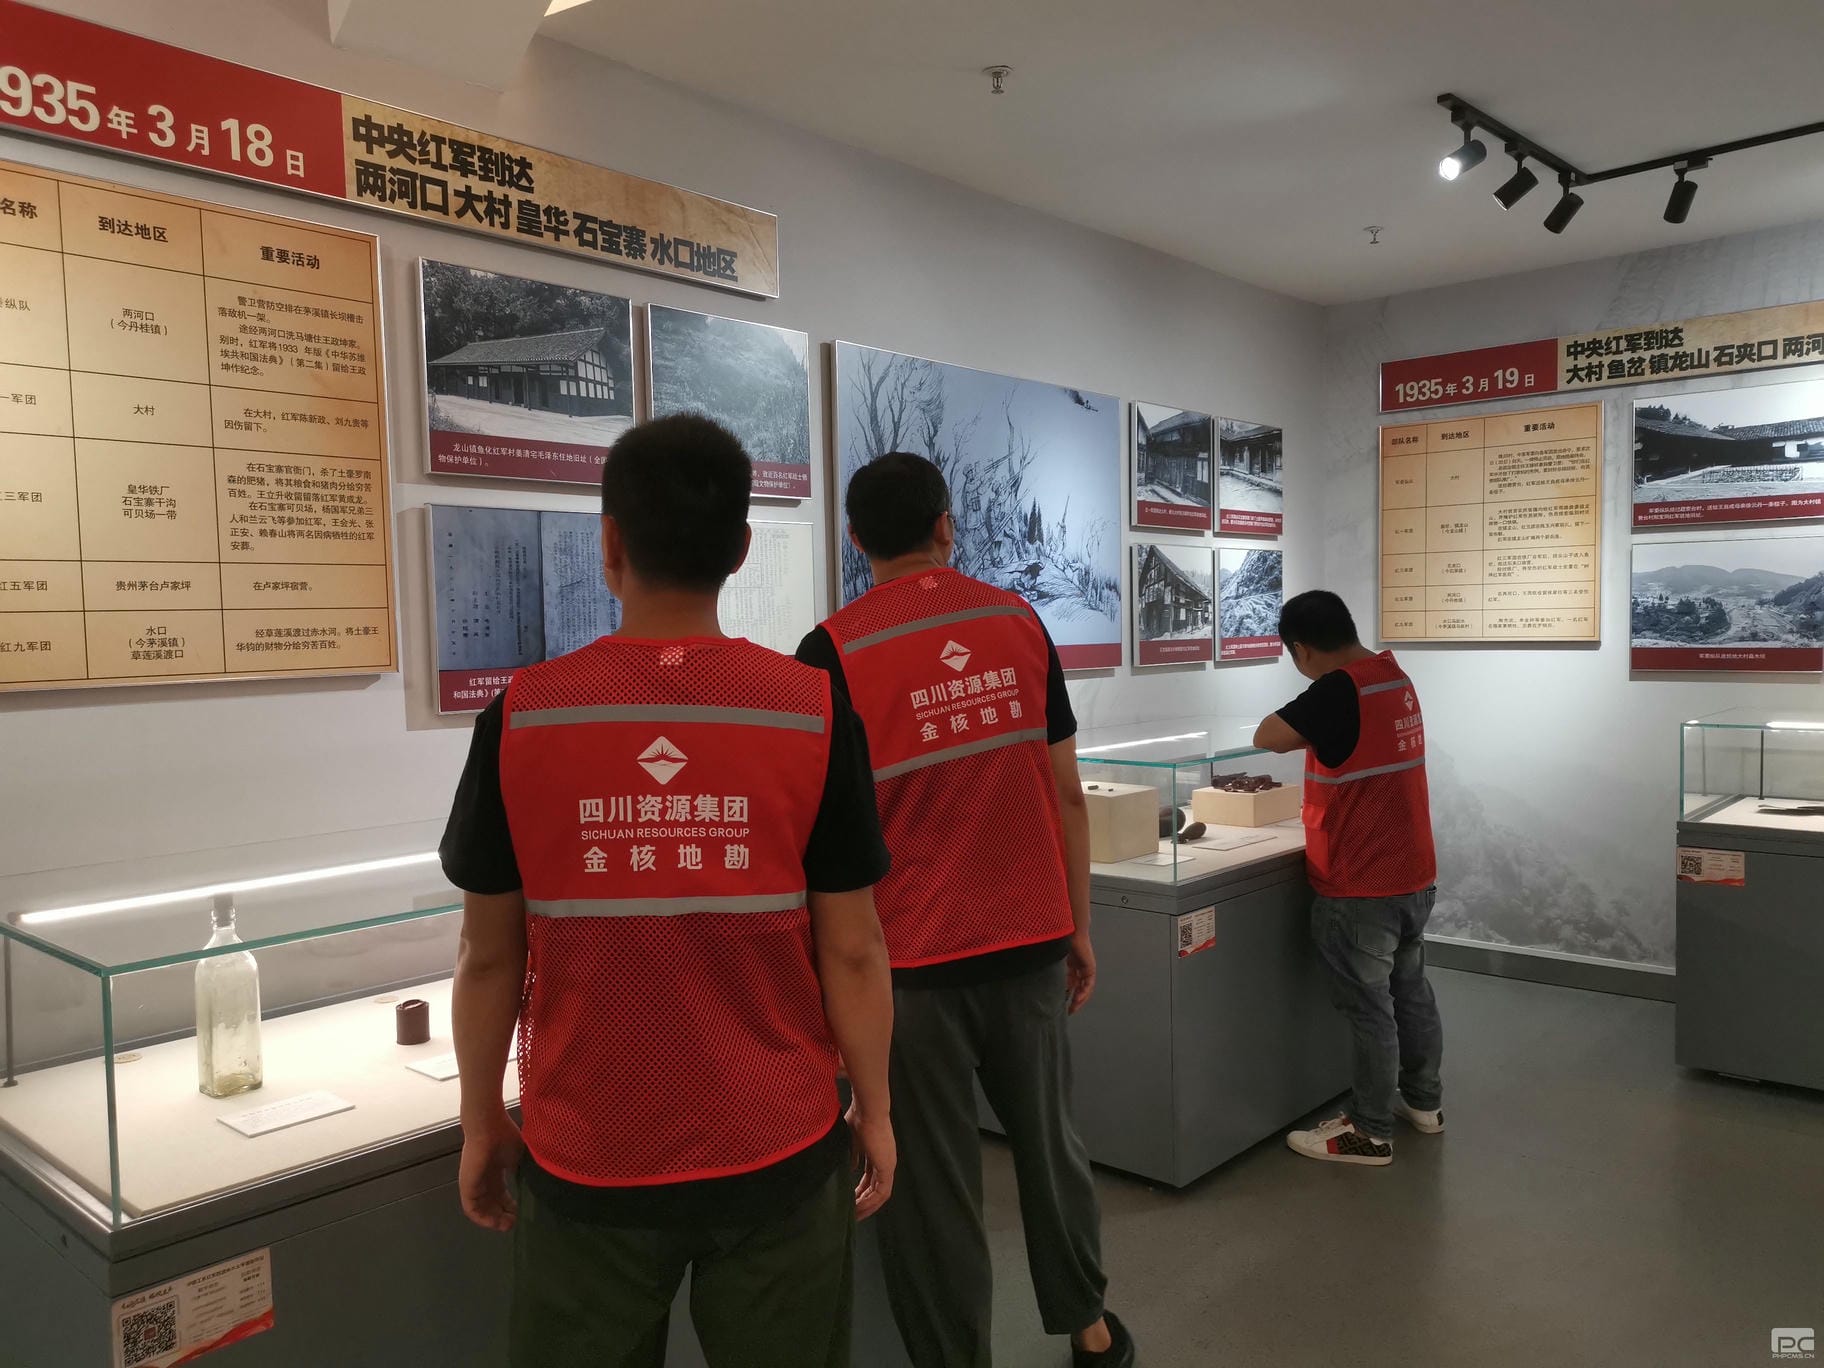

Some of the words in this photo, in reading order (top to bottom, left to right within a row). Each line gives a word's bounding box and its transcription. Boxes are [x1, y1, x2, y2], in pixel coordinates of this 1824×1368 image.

[351, 113, 536, 194] 中央红军到达
[98, 215, 169, 243] 到达地区
[354, 158, 449, 216] 两河口
[453, 184, 511, 230] 大村
[516, 200, 570, 243] 皇华
[572, 211, 648, 262] 石宝寨
[650, 233, 739, 282] 水口地区
[259, 245, 321, 270] 重要活动
[122, 308, 155, 321] 两河口
[1565, 326, 1684, 361] 中央红军到达
[1565, 360, 1603, 385] 大村
[133, 403, 155, 416] 大村
[1523, 422, 1556, 433] 重要活动
[127, 483, 170, 496] 皇华铁厂
[122, 508, 177, 520] 可贝场一带
[115, 580, 192, 592] 贵州茅台卢家坪
[145, 625, 167, 636] 水口
[910, 667, 1017, 709] 四川资源集团
[915, 704, 951, 721] SICHUAN
[951, 693, 997, 711] RESOURCES
[997, 688, 1020, 699] GROUP
[919, 699, 1023, 742] 金核地勘
[578, 794, 749, 824] 四川资源集团
[581, 828, 634, 841] SICHUAN
[636, 827, 707, 839] RESOURCES
[708, 828, 750, 838] GROUP
[583, 843, 750, 873] 金核地勘
